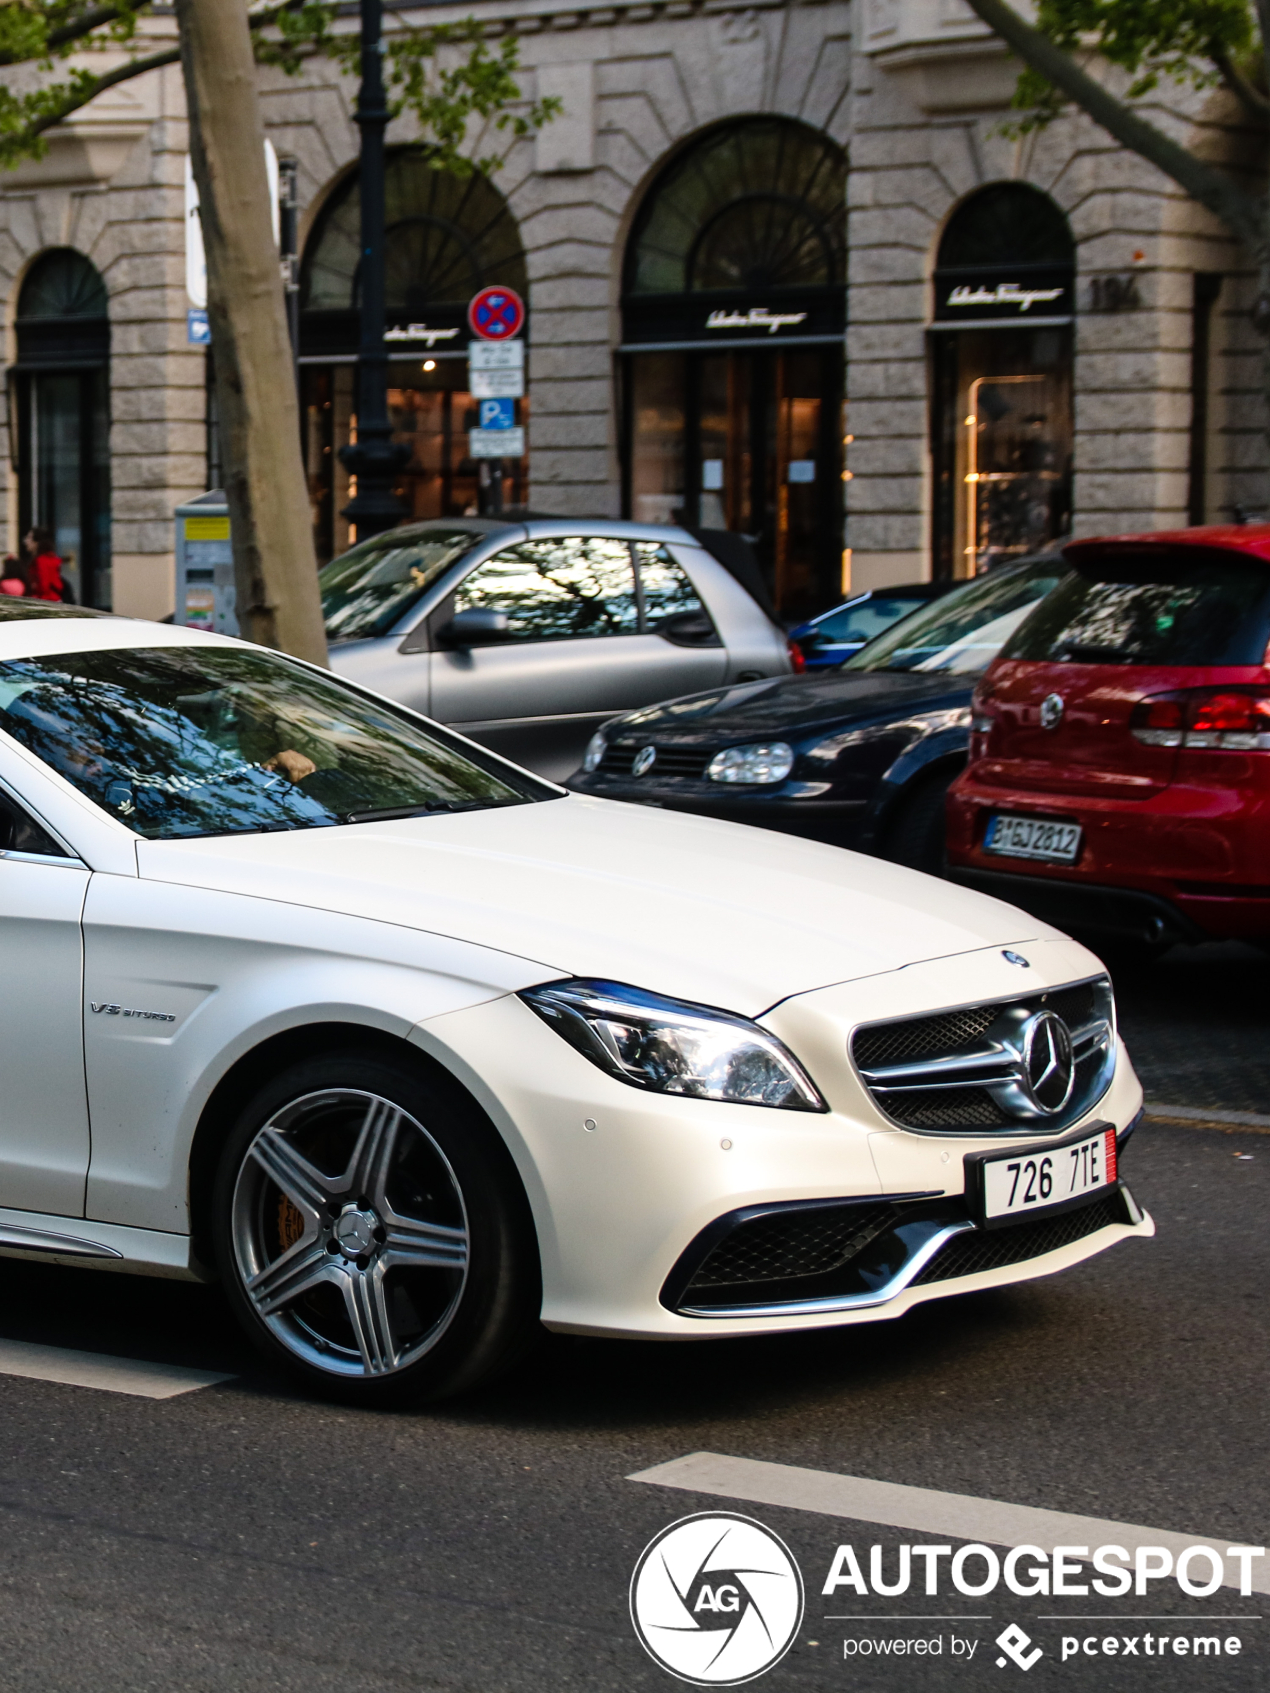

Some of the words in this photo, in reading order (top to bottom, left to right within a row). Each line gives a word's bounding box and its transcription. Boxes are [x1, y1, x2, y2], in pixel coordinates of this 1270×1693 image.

[90, 1001, 121, 1015] V8
[123, 1008, 177, 1022] BITURBO
[1007, 1156, 1053, 1207] 726
[1070, 1140, 1100, 1192] 7TE
